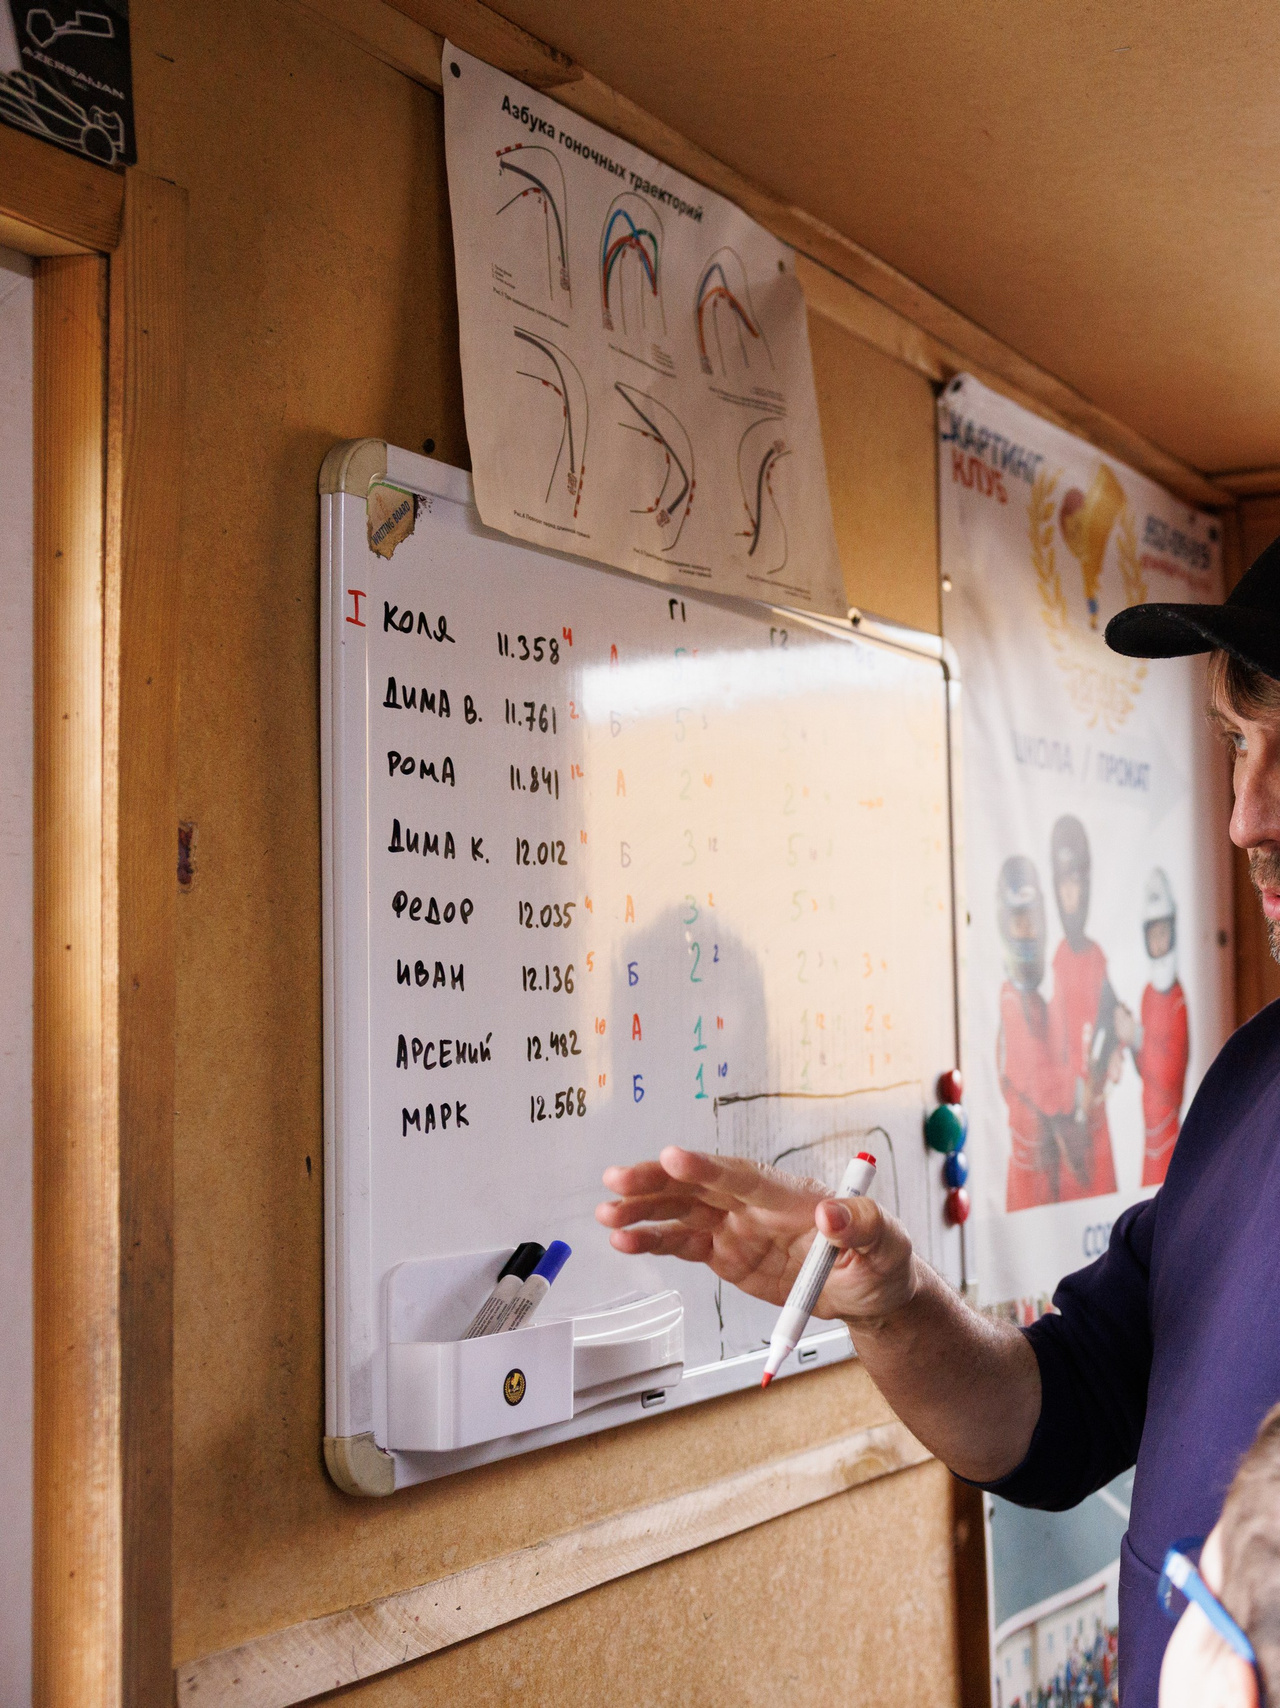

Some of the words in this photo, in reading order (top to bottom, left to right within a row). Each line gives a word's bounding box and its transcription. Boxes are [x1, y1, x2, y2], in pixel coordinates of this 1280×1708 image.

[22, 47, 125, 100] AZERBAIJAN
[501, 94, 555, 140] Азбука
[558, 131, 627, 180] гоночных
[629, 171, 704, 224] траекторий
[951, 446, 1009, 505] КЛУБ
[371, 517, 395, 546] WRITING
[392, 500, 411, 524] BOARD
[496, 631, 561, 665] 11.358
[383, 676, 451, 718] ДИМА
[463, 694, 483, 725] В.
[504, 698, 557, 734] 11.761
[387, 750, 456, 787] РОМА
[509, 764, 560, 800] 11.841
[616, 769, 627, 797] А
[1095, 752, 1152, 793] ПРОКАТ
[387, 818, 456, 859] ДИМА
[470, 836, 490, 864] К.
[515, 837, 568, 867] 12.012
[519, 899, 577, 929] 12.035
[625, 894, 635, 923] А
[396, 958, 465, 992] ИВАН
[522, 964, 576, 995] 12.136
[627, 961, 639, 987] Б
[690, 941, 704, 983] 2
[396, 1032, 493, 1070] АРСЕНИЙ
[526, 1029, 582, 1062] 12.482
[631, 1013, 642, 1041] А
[693, 1015, 707, 1052] 1
[402, 1101, 470, 1137] МАРК
[529, 1086, 587, 1122] 12.568
[632, 1073, 645, 1104] Б
[694, 1062, 709, 1100] 1
